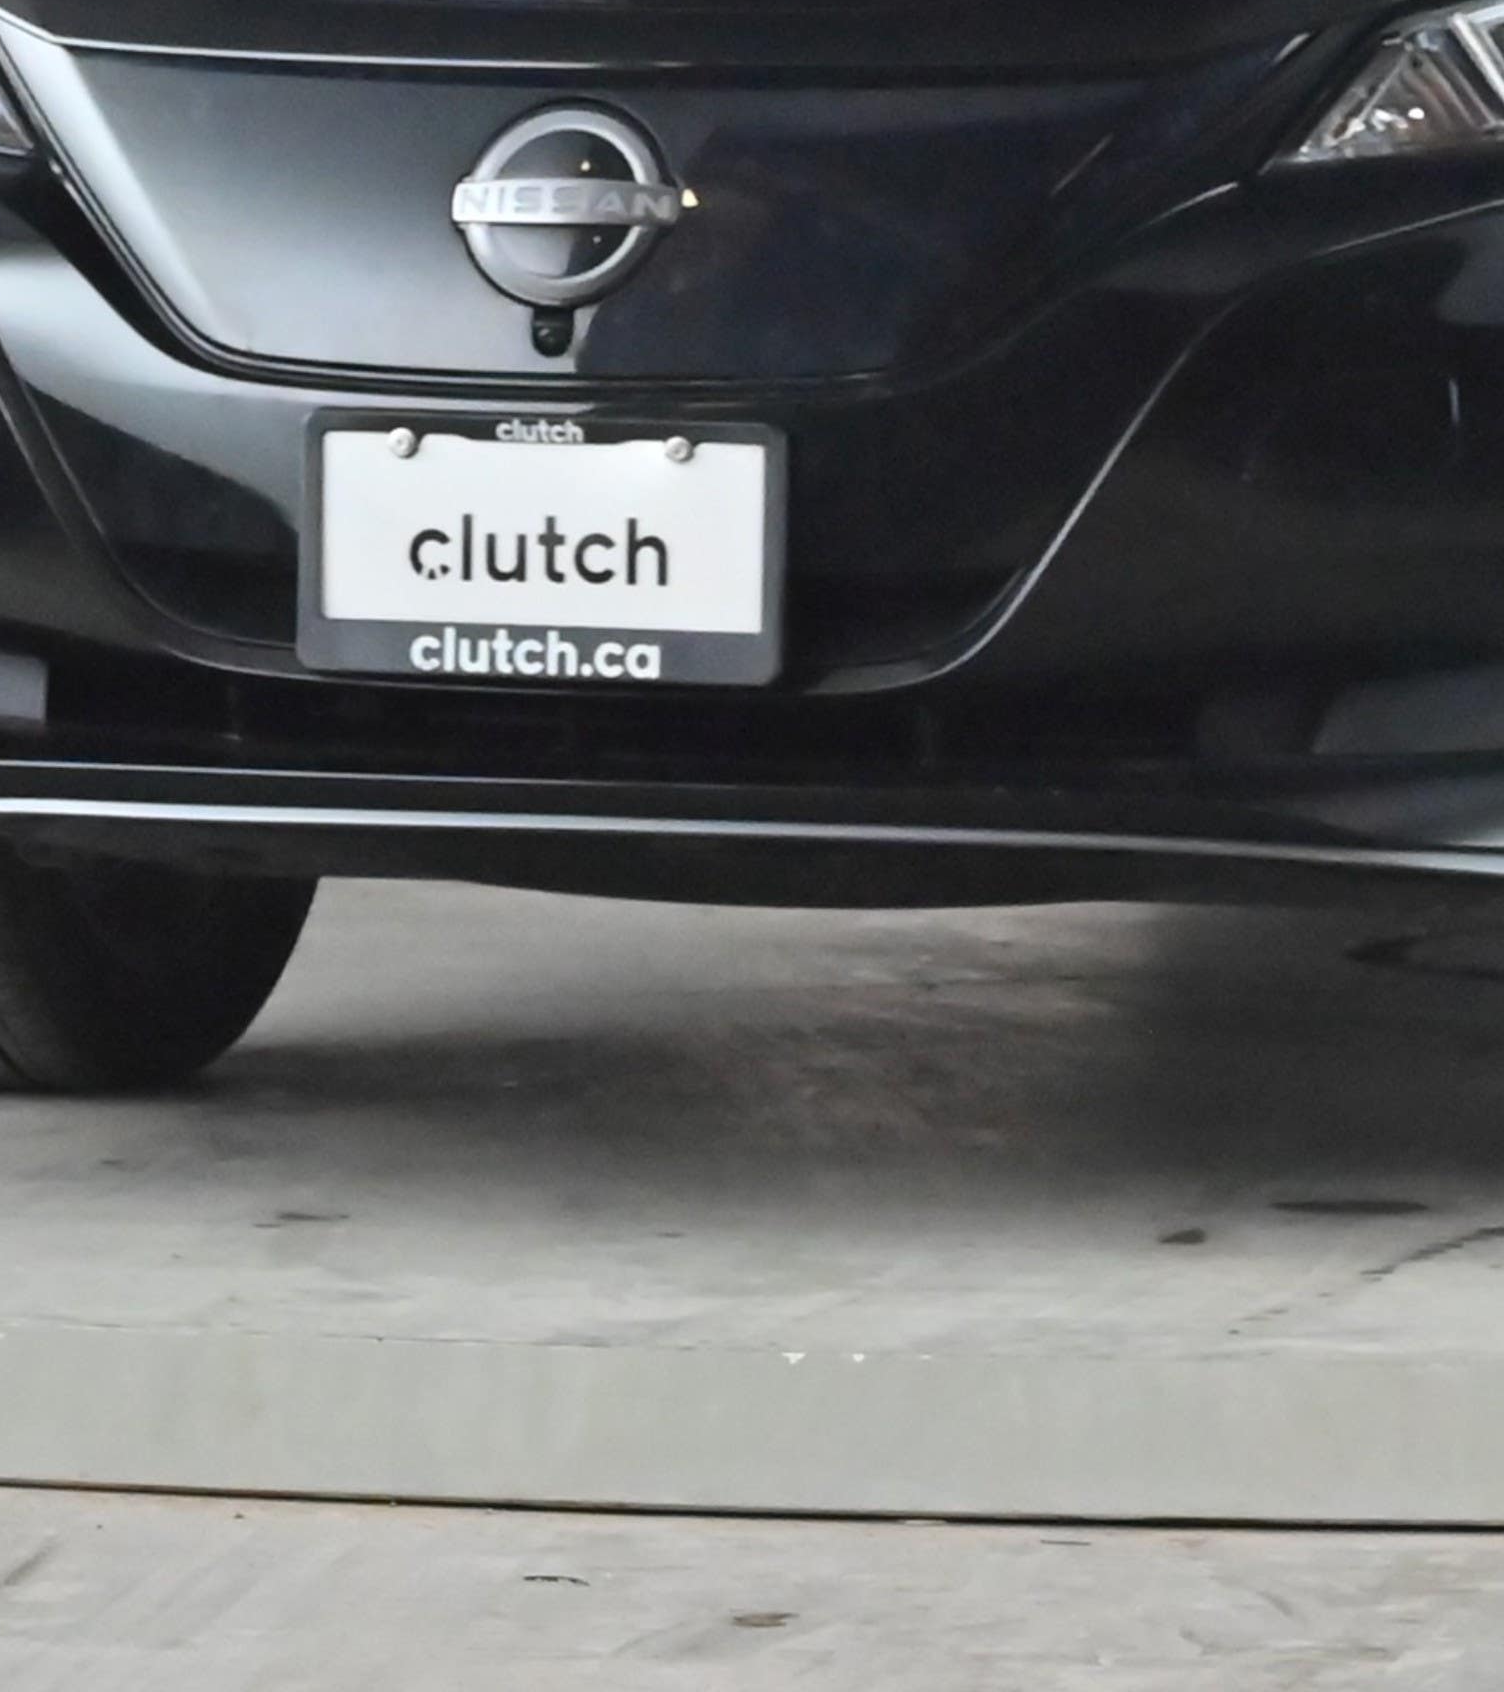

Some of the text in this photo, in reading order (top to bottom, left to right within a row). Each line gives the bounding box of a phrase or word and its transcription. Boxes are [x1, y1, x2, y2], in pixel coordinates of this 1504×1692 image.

[461, 185, 674, 218] NISSAN
[496, 419, 584, 444] clutch
[409, 513, 669, 586] clutch
[409, 627, 661, 679] clutch.ca
